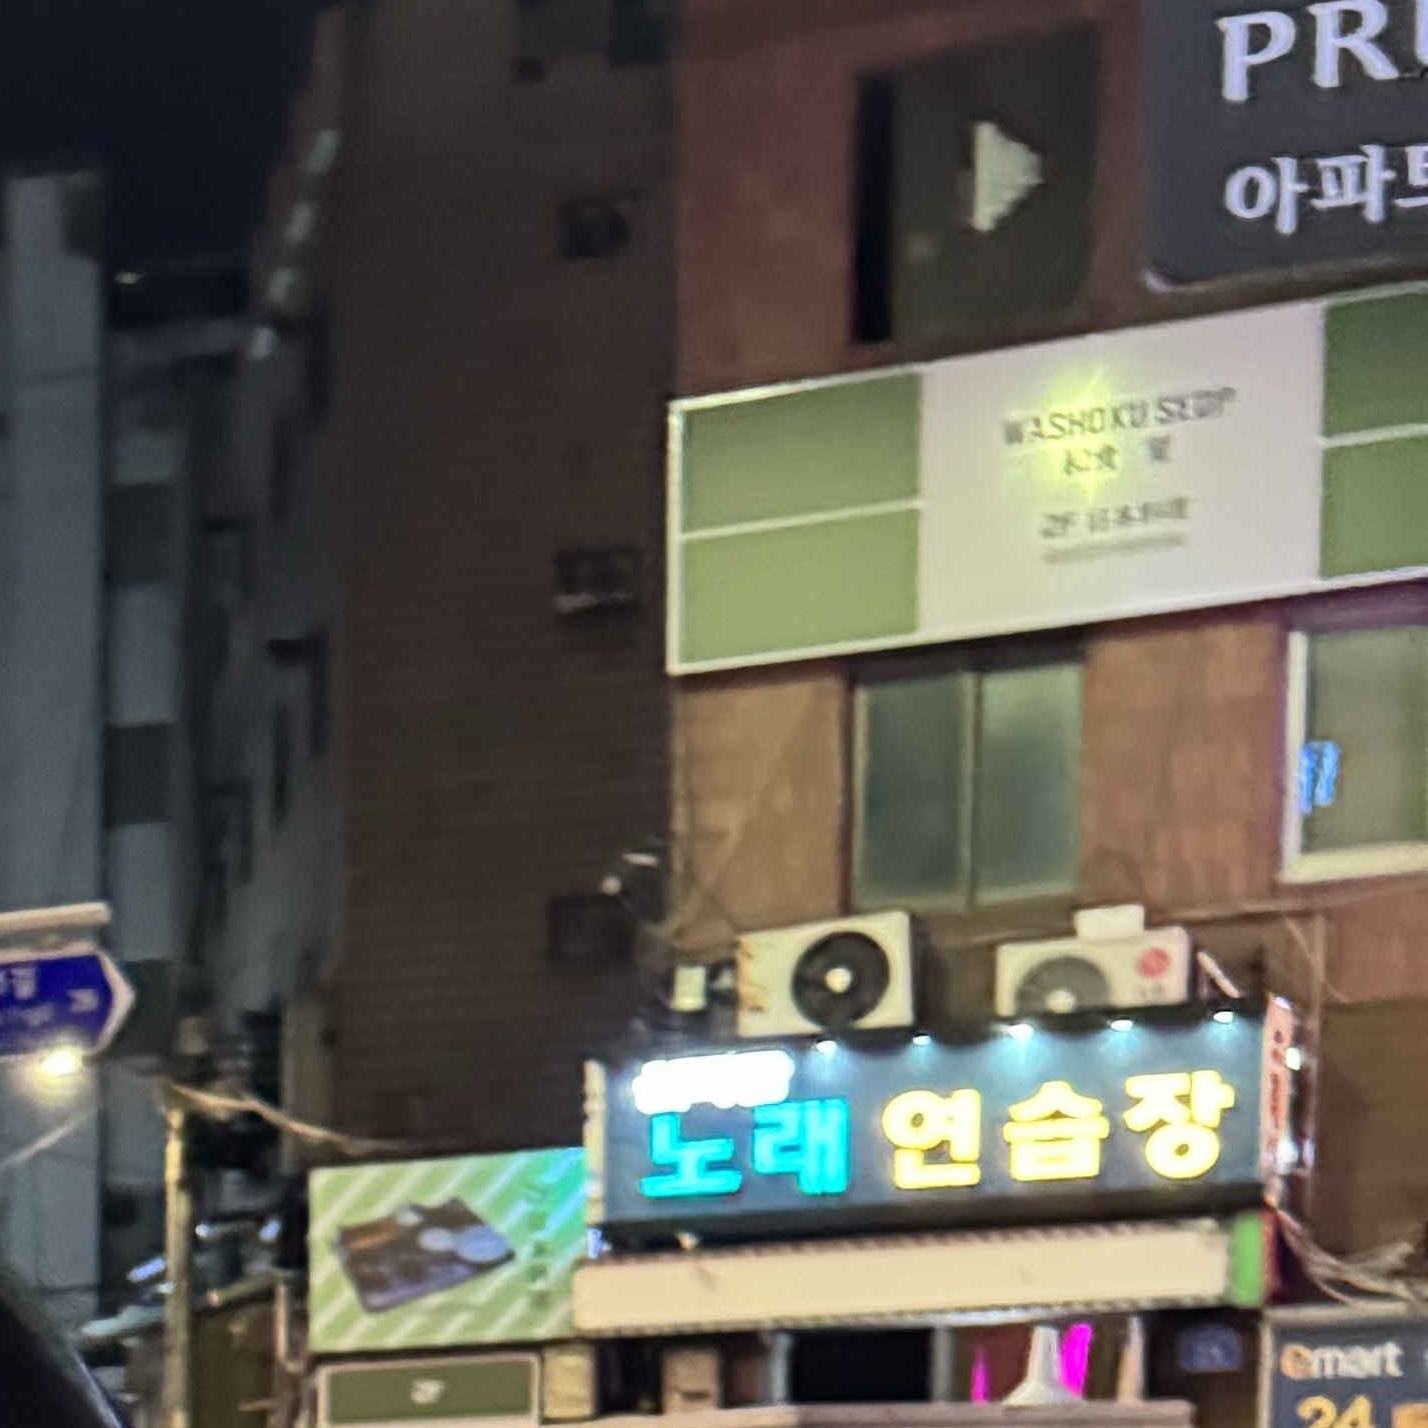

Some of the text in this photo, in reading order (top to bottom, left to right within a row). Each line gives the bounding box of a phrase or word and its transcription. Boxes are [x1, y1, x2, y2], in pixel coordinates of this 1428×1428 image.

[1216, 0, 1428, 102] PR
[881, 1069, 1236, 1190] 연습장
[1280, 1341, 1403, 1380] emart
